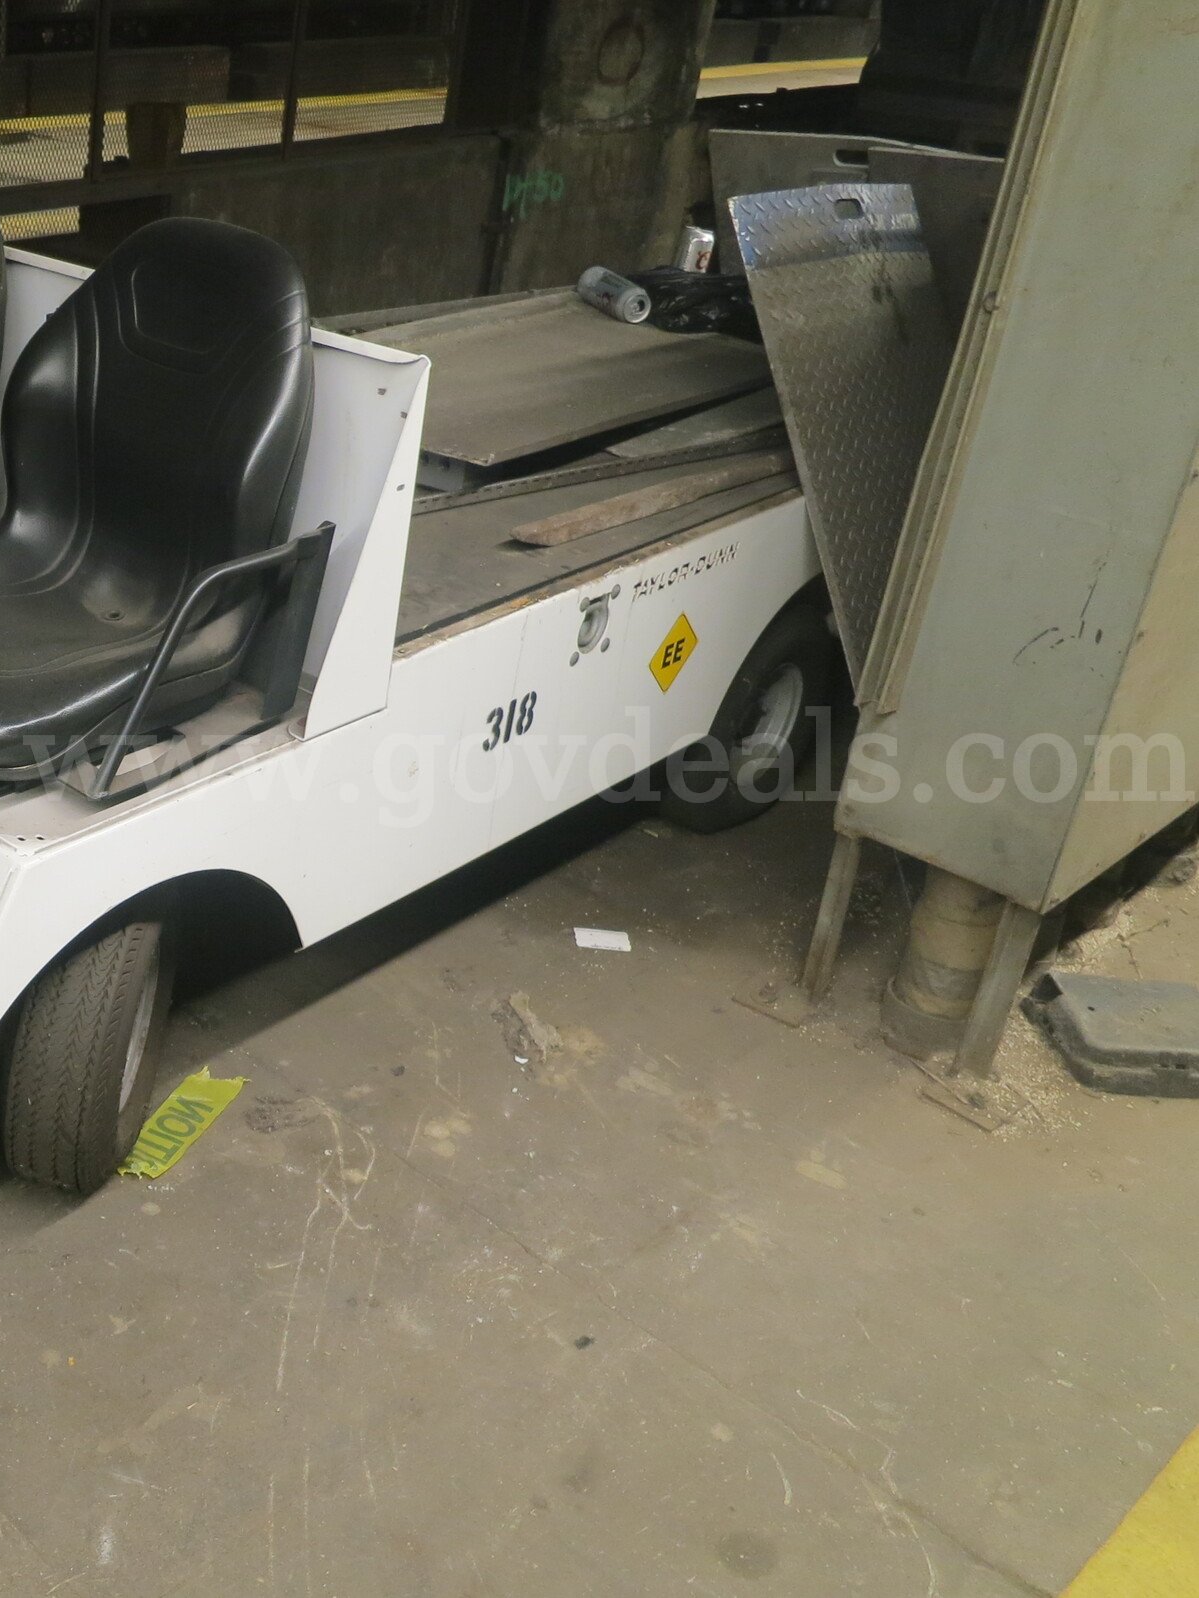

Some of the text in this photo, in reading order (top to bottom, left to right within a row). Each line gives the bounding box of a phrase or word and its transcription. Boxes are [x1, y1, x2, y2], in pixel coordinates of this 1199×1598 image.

[631, 541, 740, 602] TAYLOR-DUNN
[661, 638, 685, 669] EE
[482, 691, 537, 751] 318
